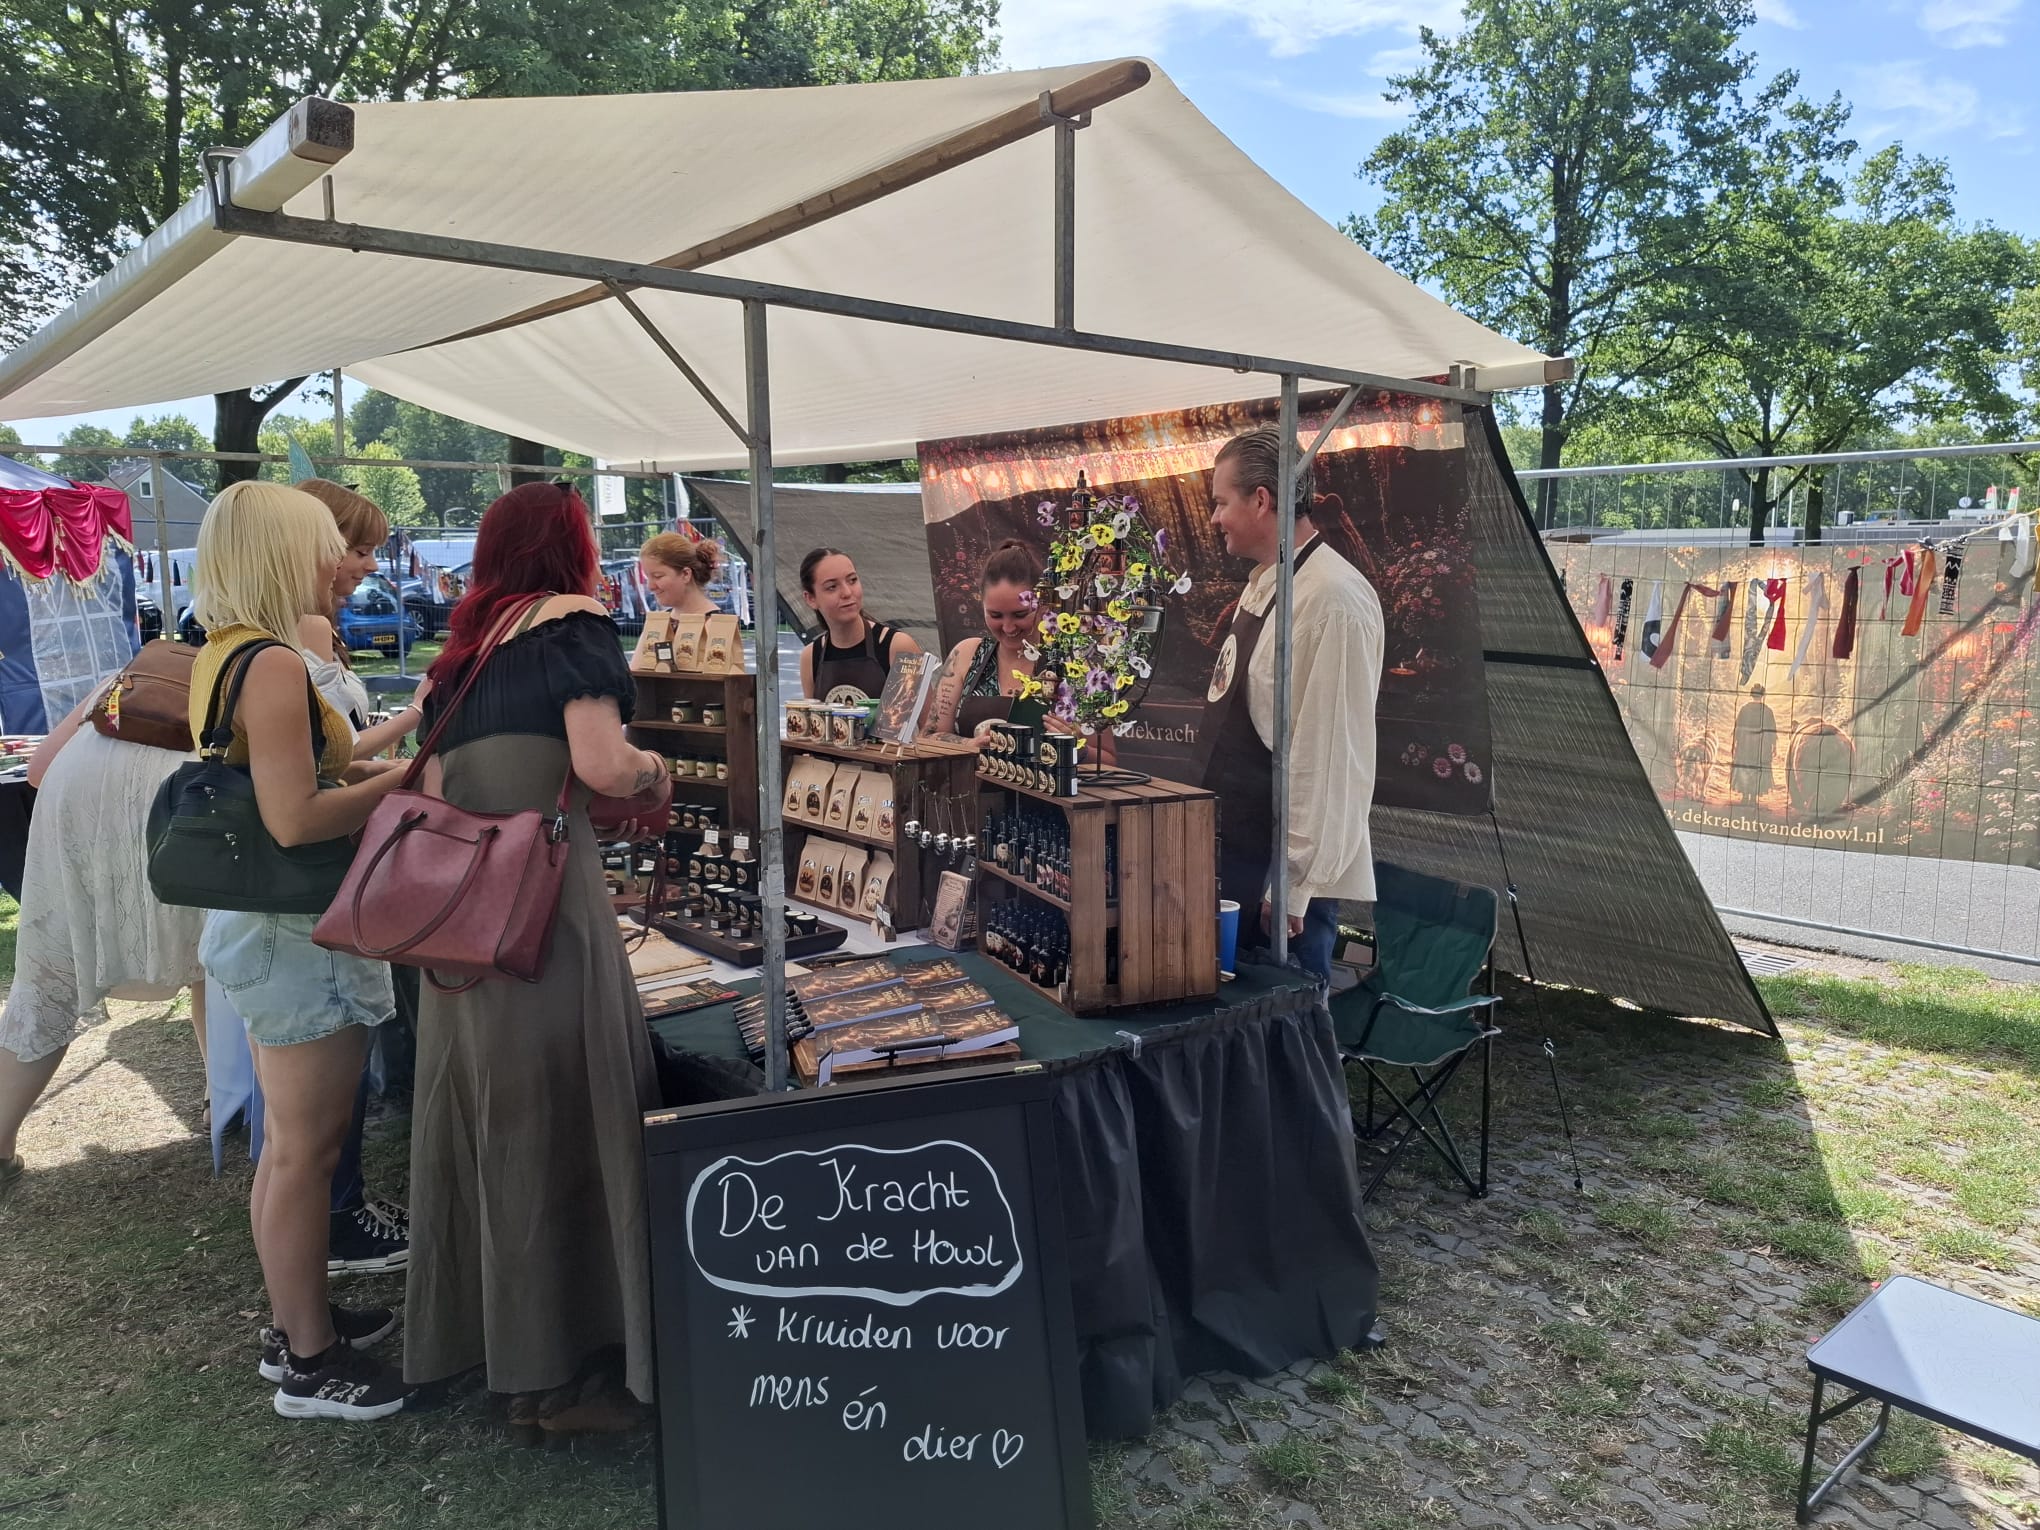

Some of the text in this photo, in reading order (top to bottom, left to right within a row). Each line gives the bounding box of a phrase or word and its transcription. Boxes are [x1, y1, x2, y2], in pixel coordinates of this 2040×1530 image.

[1112, 721, 1199, 743] dekrach
[718, 1158, 969, 1237] De Kracht
[846, 1233, 894, 1262] de
[913, 1229, 1002, 1266] Howl
[937, 1323, 1010, 1349] voor
[750, 1375, 887, 1430] mens én
[904, 1424, 982, 1462] dier
